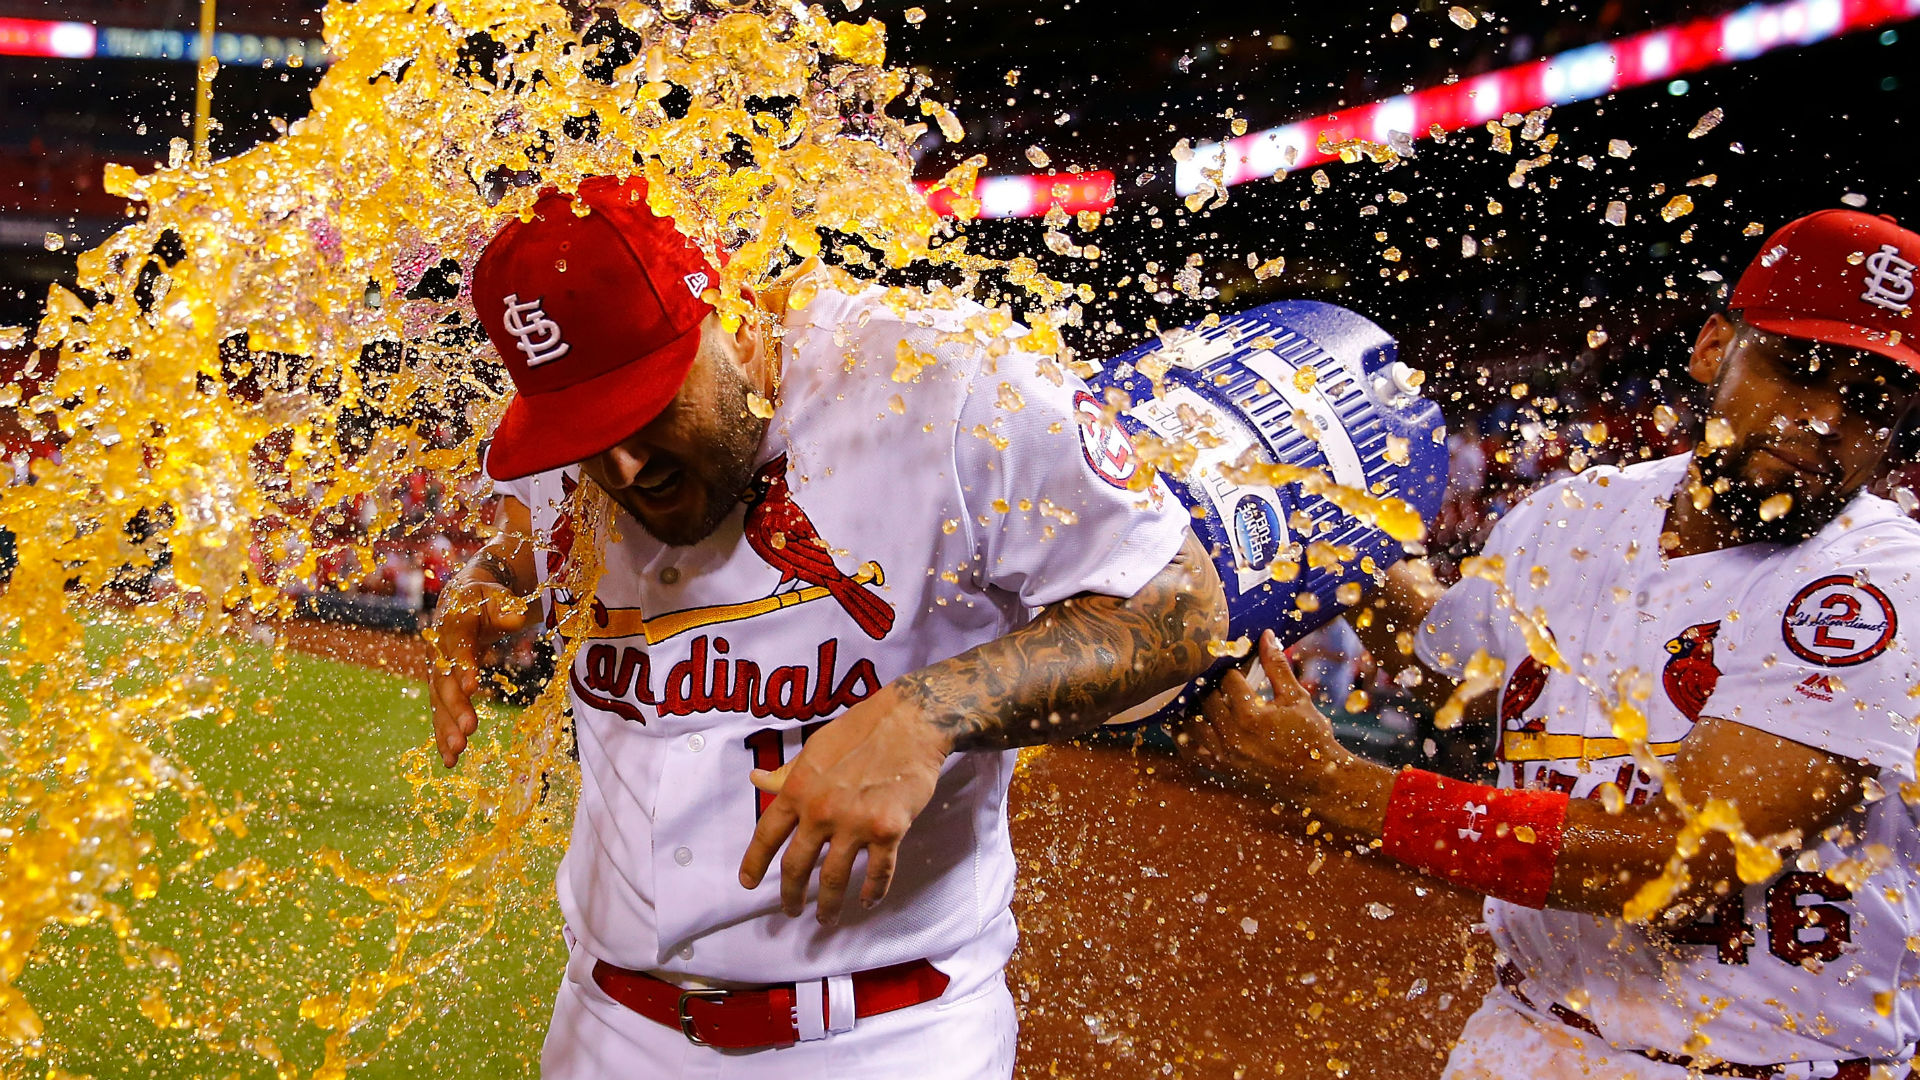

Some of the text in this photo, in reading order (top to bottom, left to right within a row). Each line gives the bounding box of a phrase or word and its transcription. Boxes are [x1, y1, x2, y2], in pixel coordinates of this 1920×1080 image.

[1237, 503, 1264, 567] DEFIANCE
[1256, 511, 1272, 545] FUEL
[1813, 593, 1862, 650] 2
[569, 635, 885, 726] ardinals
[1796, 684, 1834, 702] Majestic
[1662, 871, 1852, 966] 46
